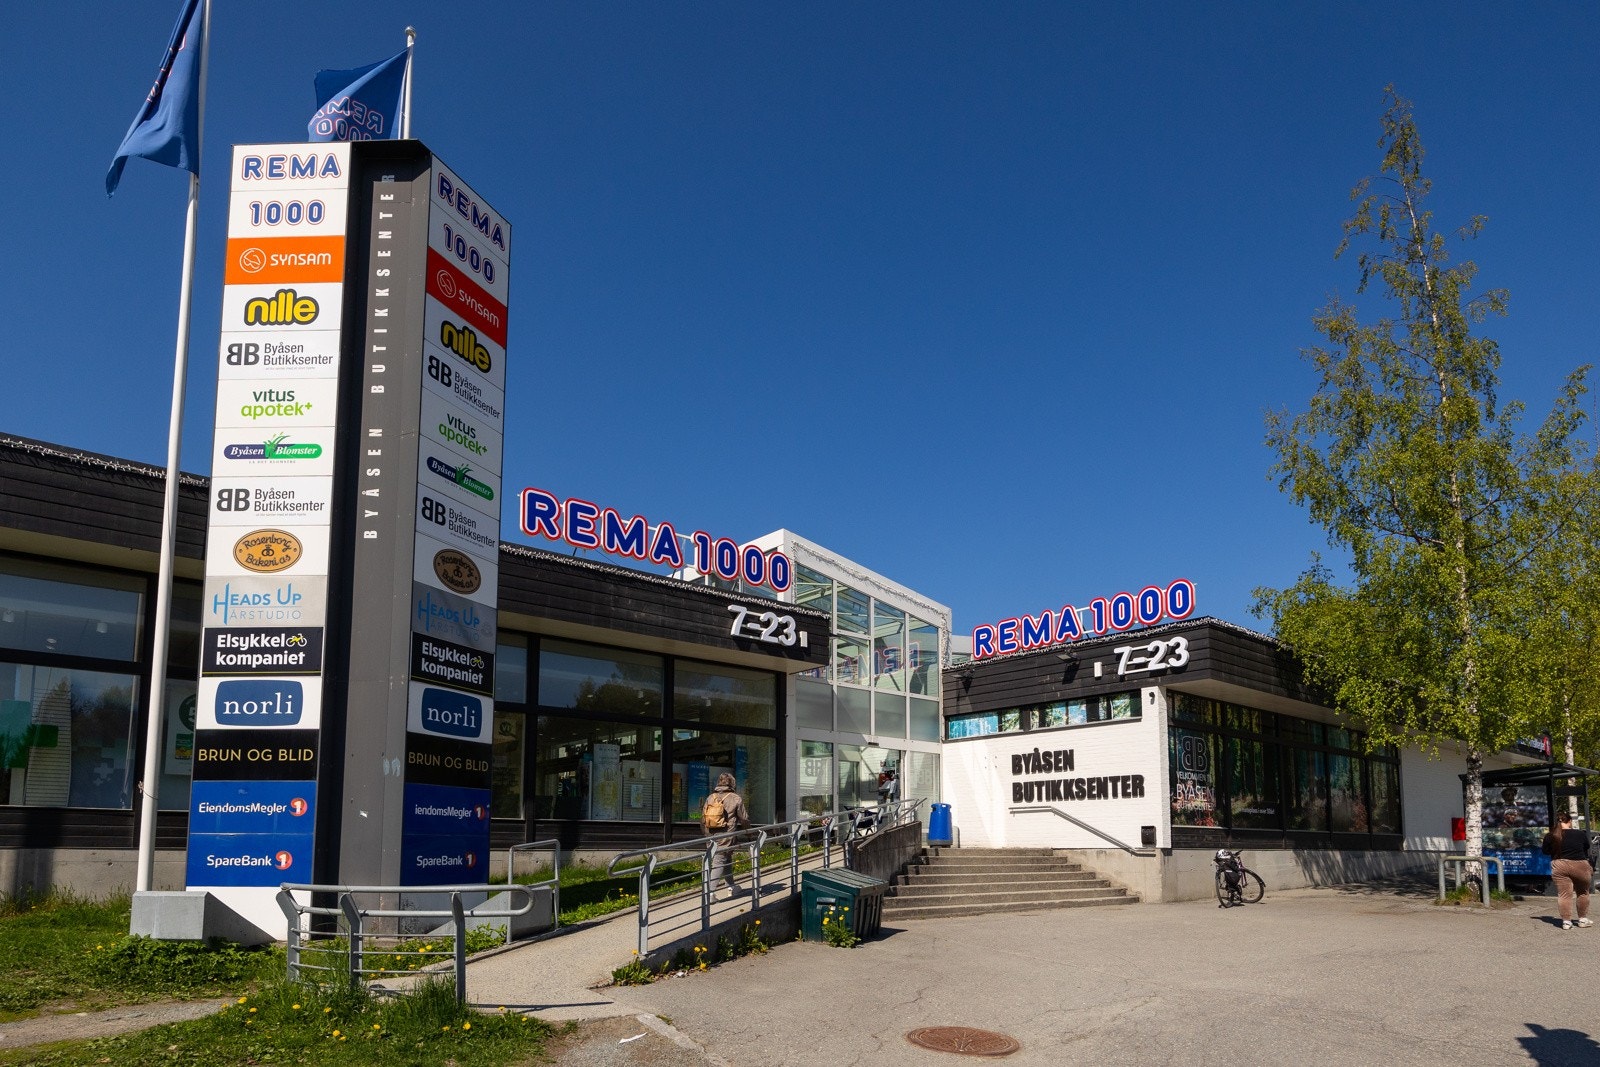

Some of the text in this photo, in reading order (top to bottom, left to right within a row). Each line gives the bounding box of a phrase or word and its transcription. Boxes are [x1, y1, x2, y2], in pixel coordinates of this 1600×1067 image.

[242, 153, 341, 181] REMA
[249, 200, 325, 226] 1000
[438, 172, 505, 251] REMA
[270, 253, 331, 267] SYNSAM
[444, 223, 495, 285] 1000
[245, 290, 318, 325] nille
[459, 289, 499, 327] SYNSAM
[264, 341, 304, 356] Byåsen
[361, 175, 395, 539] BYÅSEN BUTIKKSENTER
[442, 322, 490, 372] nille
[263, 354, 334, 366] Butikksenter
[252, 389, 295, 402] vitus
[454, 372, 482, 397] Byåsen
[454, 383, 500, 419] Butikksenter
[447, 413, 476, 439] vitus
[230, 446, 318, 457] Byåsen Blomster
[432, 460, 456, 479] Byåsen
[463, 476, 492, 496] Blomster
[253, 500, 325, 512] Butikksenter
[254, 487, 295, 502] Byåsen
[448, 508, 477, 529] Byåsen
[243, 534, 292, 553] Rosenborg
[448, 519, 495, 548] Butikksenter
[520, 487, 794, 593] REMA 1000
[727, 604, 797, 647] 7-23
[972, 578, 1198, 660] REMA 1000
[217, 634, 285, 650] Elsykkel
[422, 641, 470, 666] Elsykkel
[215, 650, 306, 668] kompaniet
[1113, 636, 1190, 676] 7-23
[421, 658, 483, 684] kompaniet
[222, 691, 294, 714] norli
[427, 706, 476, 728] norli
[198, 749, 314, 761] BRUN OG BLID
[408, 752, 489, 772] BRUN OG BLID
[1011, 747, 1075, 775] BYÅSEN
[1012, 774, 1145, 803] BUTIKKSENTER
[198, 802, 287, 815] EiendomsMegler
[206, 855, 272, 868] SpareBank
[416, 856, 463, 868] SpareBank
